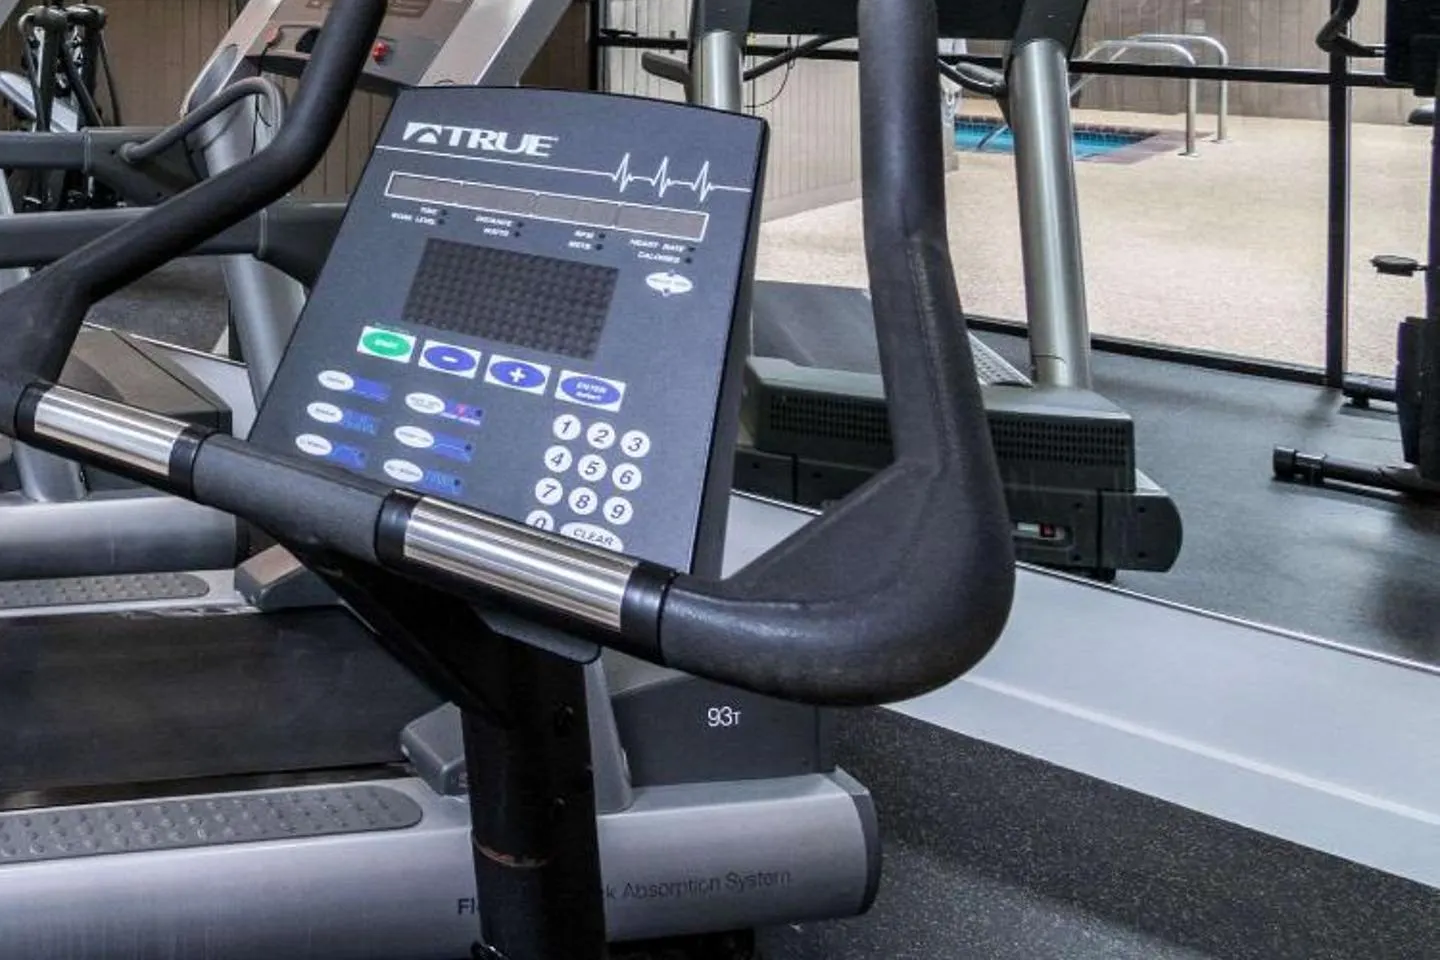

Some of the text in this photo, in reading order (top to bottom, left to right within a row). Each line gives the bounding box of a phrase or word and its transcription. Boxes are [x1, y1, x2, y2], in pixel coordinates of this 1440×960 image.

[442, 126, 559, 157] TRUE
[561, 419, 643, 452] 1 2 3
[551, 452, 634, 485] 4 5 6
[541, 484, 626, 519] 7 8 9
[573, 527, 614, 547] CLEAR
[622, 876, 721, 900] Absorption
[725, 870, 792, 894] System
